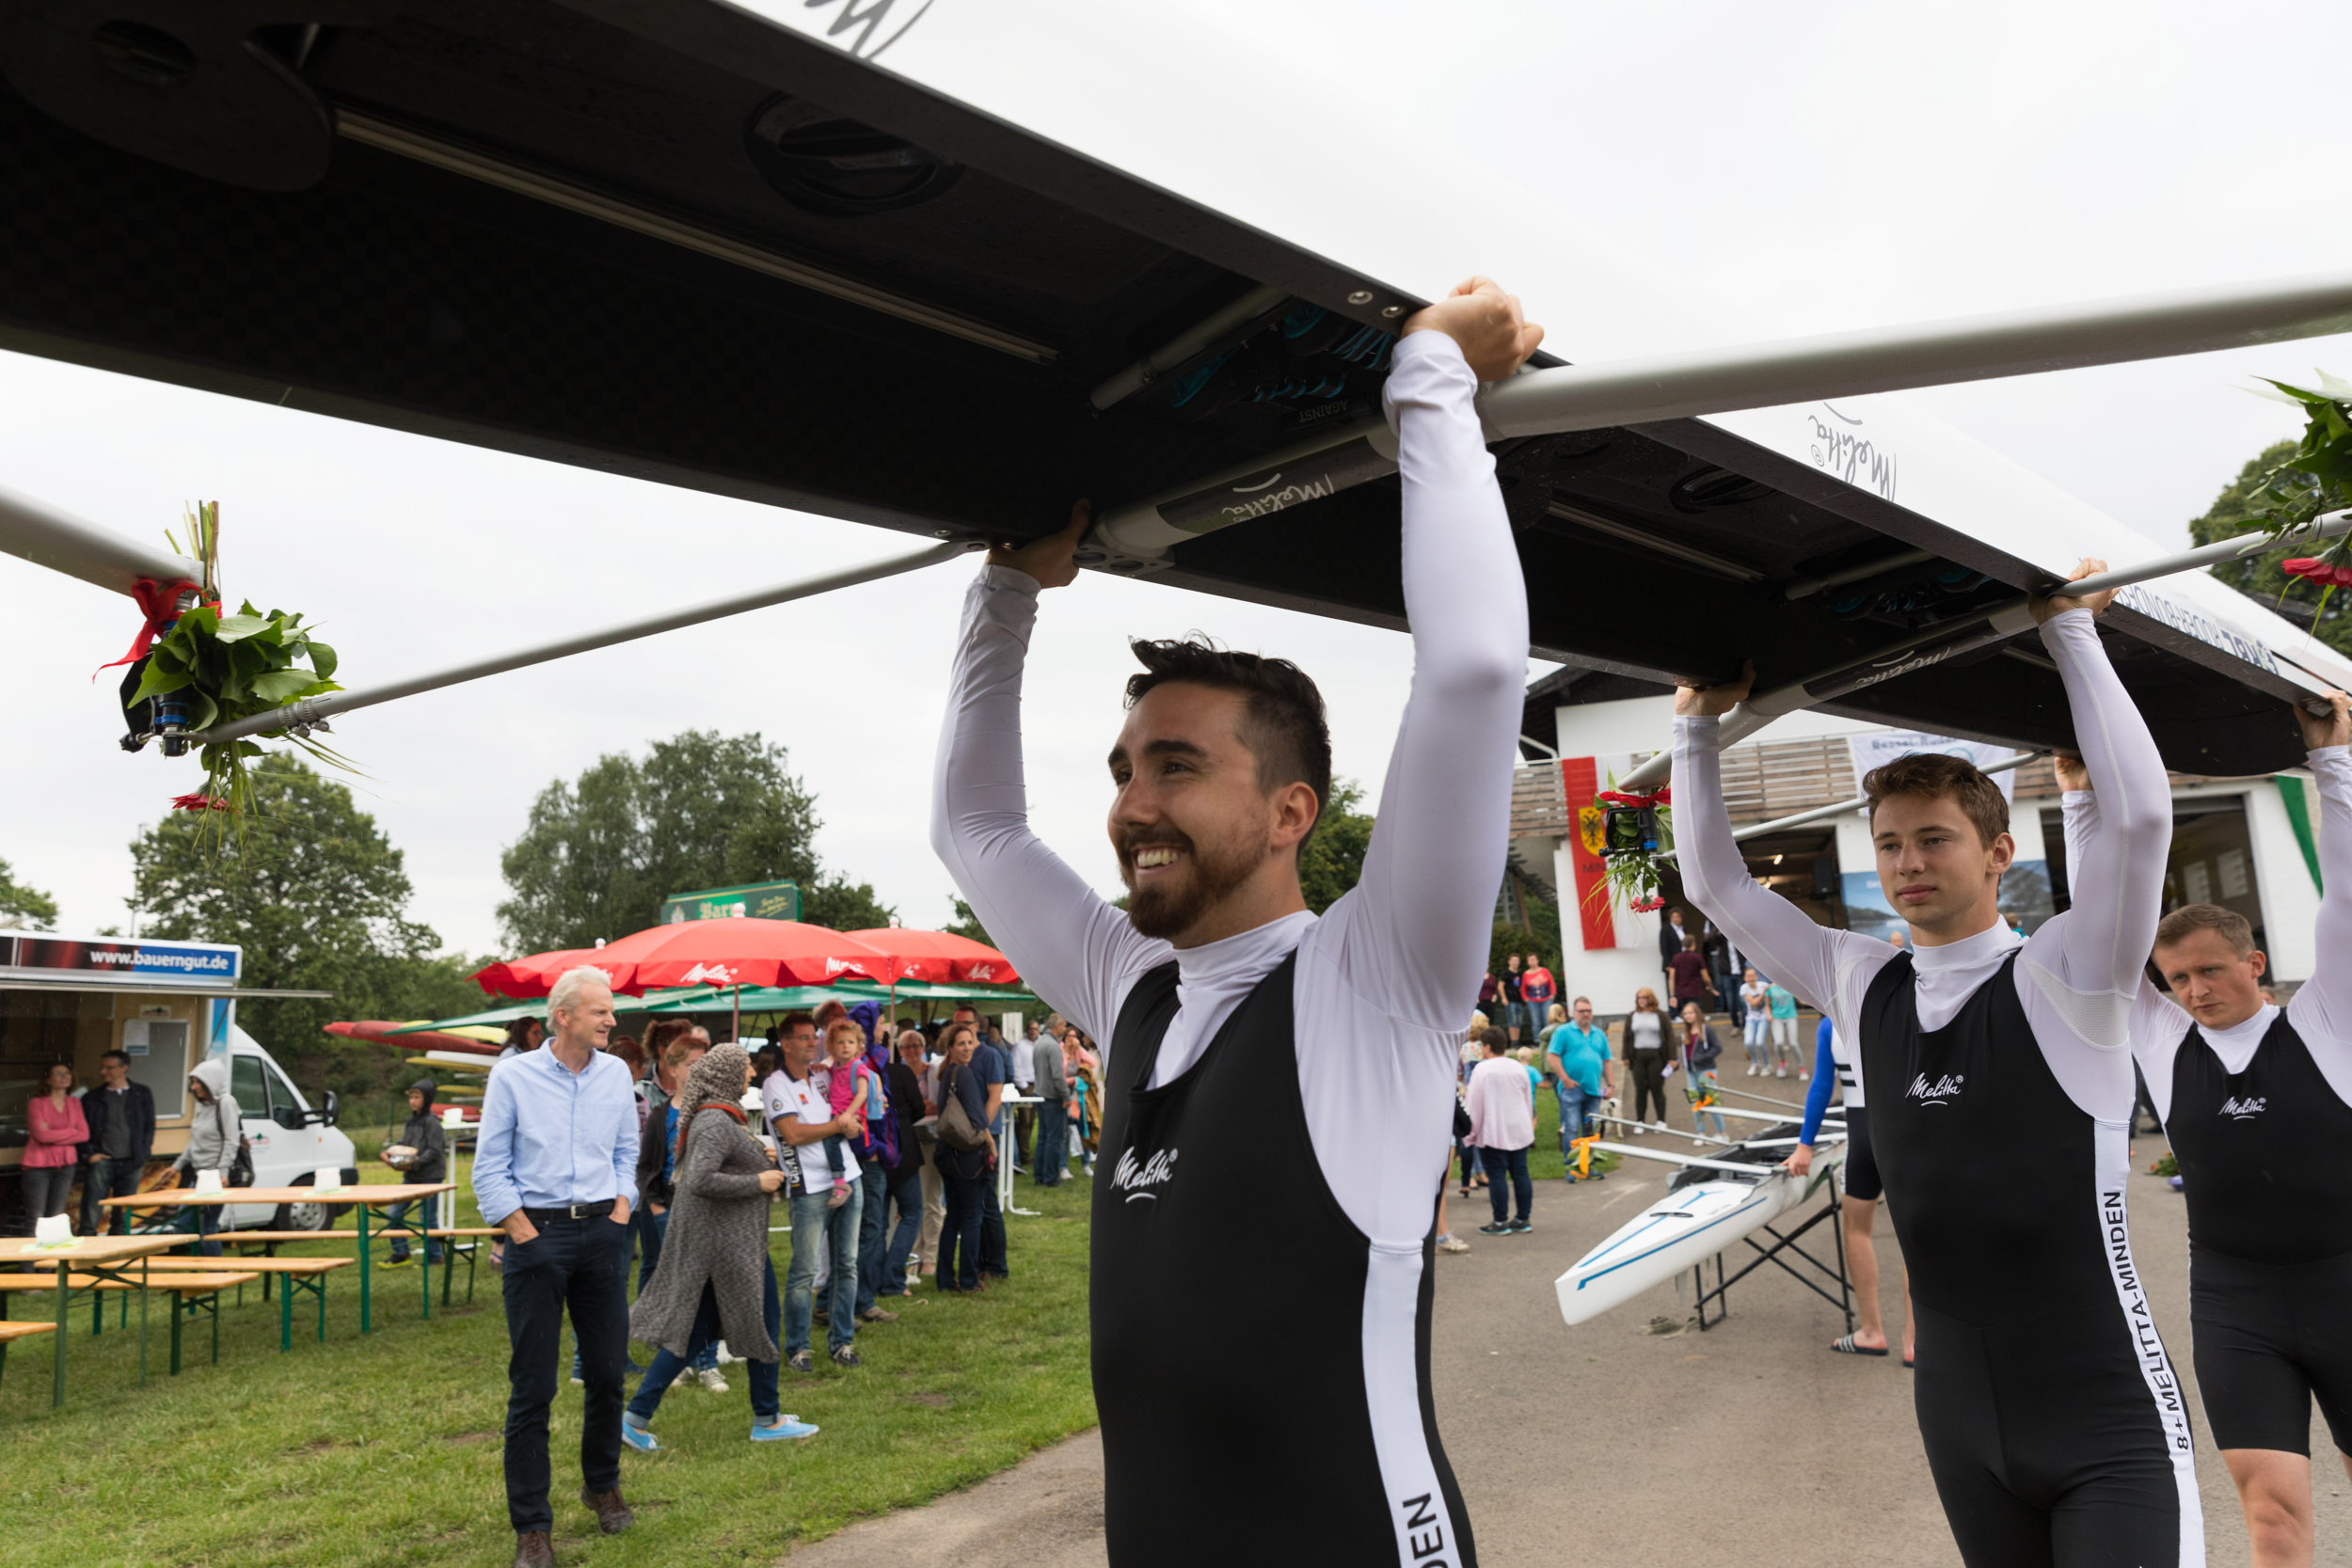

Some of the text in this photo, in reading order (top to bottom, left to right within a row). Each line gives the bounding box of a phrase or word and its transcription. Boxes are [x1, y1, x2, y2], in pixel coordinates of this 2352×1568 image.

[1299, 399, 1348, 422] AGAINST
[90, 950, 229, 971] www.bauerngut.de
[1904, 1072, 1964, 1099] Melitta
[2217, 1096, 2266, 1116] Melitta
[1109, 1146, 1178, 1191] Melitta
[2103, 1192, 2180, 1412] MELITTA-MINDEN
